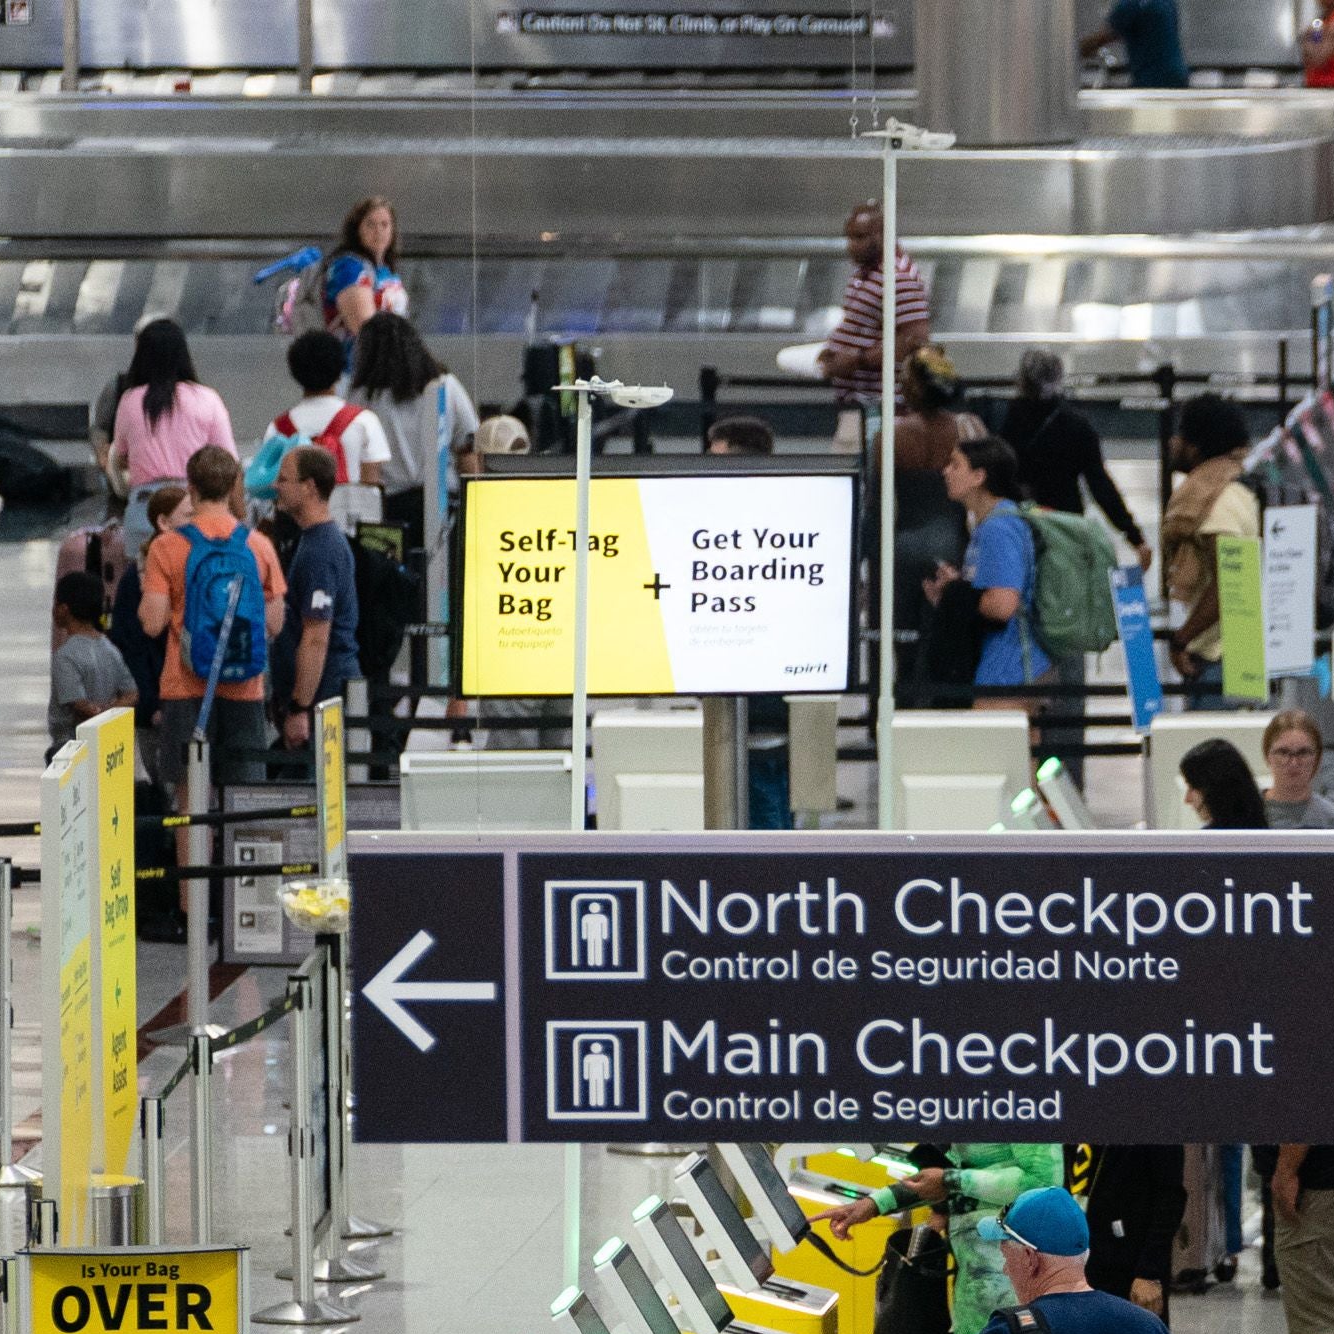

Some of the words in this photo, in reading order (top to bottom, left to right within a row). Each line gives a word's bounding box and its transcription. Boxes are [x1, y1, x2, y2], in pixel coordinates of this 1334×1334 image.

[499, 528, 620, 558] Self-Tag
[692, 529, 741, 550] Get
[752, 528, 820, 550] Your
[498, 562, 566, 584] Your
[691, 557, 825, 586] Boarding
[498, 594, 553, 621] Bag
[691, 592, 757, 614] Pass
[784, 661, 829, 676] spirit
[105, 742, 125, 777] spirit
[661, 877, 865, 935] North
[894, 876, 1313, 946] Checkpoint
[661, 950, 799, 980] Control
[812, 950, 858, 980] de
[870, 949, 1062, 985] Seguridad
[1073, 950, 1180, 980] Norte
[662, 1018, 827, 1076] Main
[856, 1017, 1274, 1087] Checkpoint
[662, 1090, 799, 1120] Control
[812, 1090, 859, 1120] de
[872, 1089, 1062, 1126] Seguridad
[81, 1263, 96, 1279] Is
[99, 1262, 140, 1278] Your
[146, 1261, 180, 1280] Bag
[51, 1283, 215, 1334] OVER
